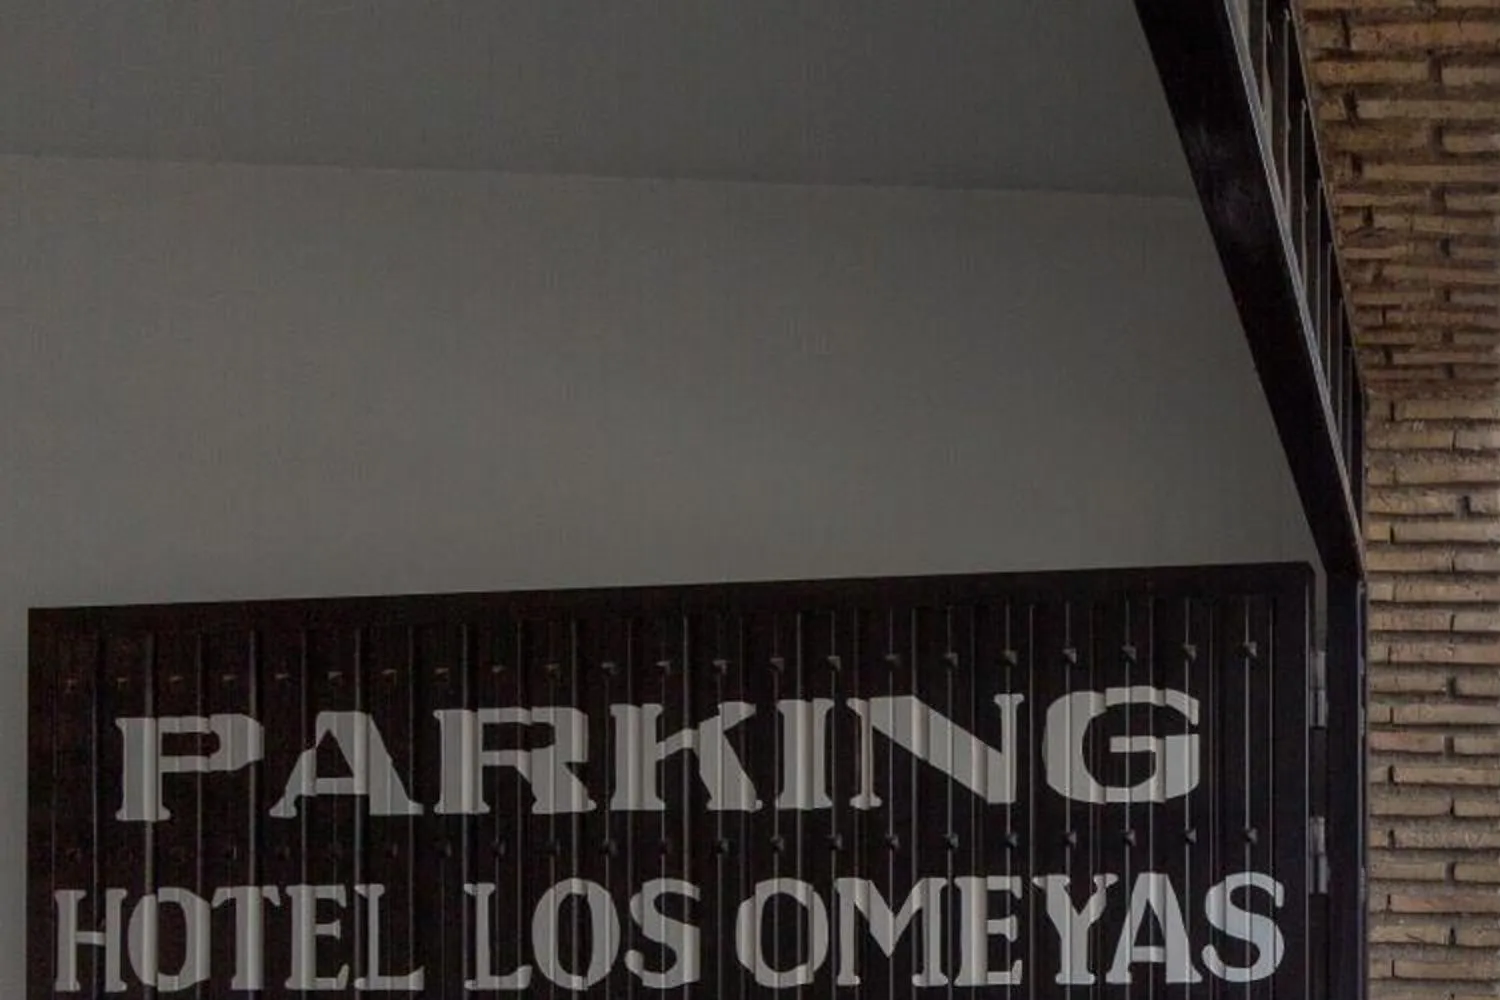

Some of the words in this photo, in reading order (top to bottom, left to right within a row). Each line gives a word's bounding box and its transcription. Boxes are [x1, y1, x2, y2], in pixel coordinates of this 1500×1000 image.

[115, 686, 1199, 821] PARKING
[54, 884, 424, 992] HOTEL
[464, 878, 700, 989] LOS
[736, 872, 1285, 988] OMEYAS
